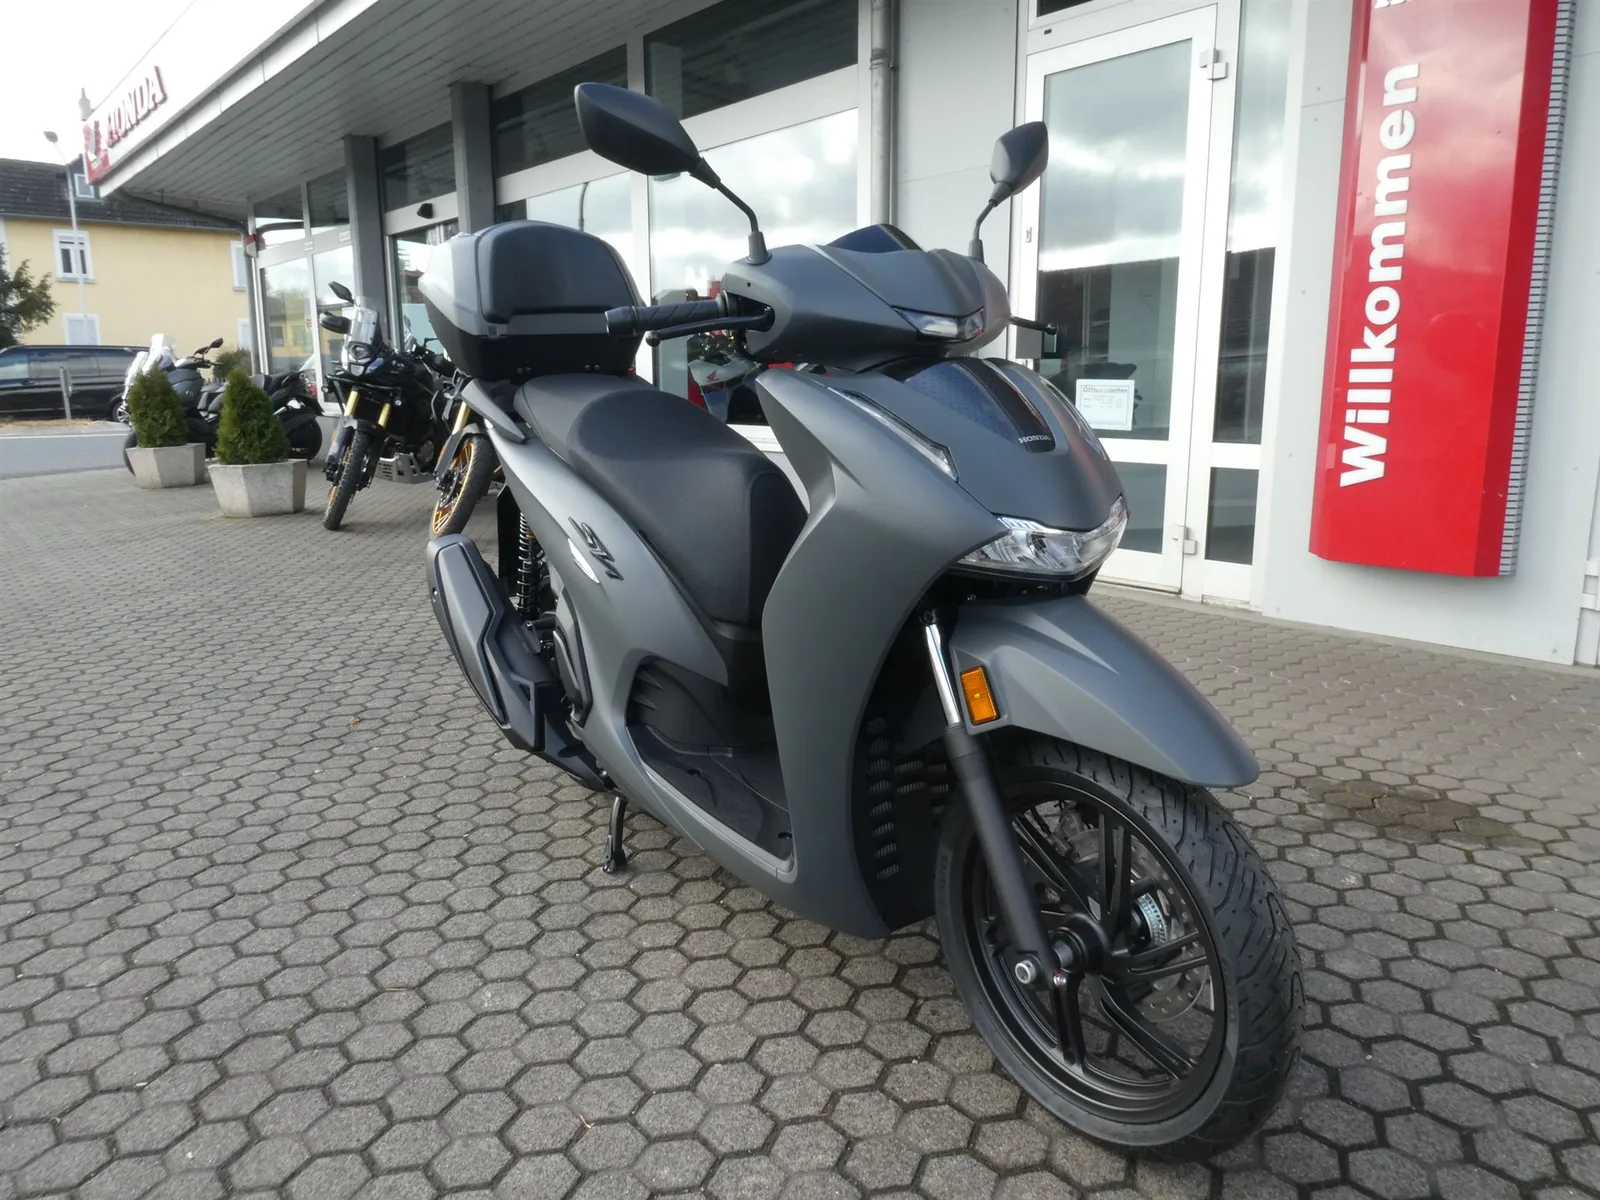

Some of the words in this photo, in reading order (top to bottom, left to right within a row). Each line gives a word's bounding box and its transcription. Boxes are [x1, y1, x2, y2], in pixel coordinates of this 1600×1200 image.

[106, 65, 168, 149] HONDA
[1340, 62, 1420, 488] Willkommen
[1018, 434, 1051, 444] HONDA
